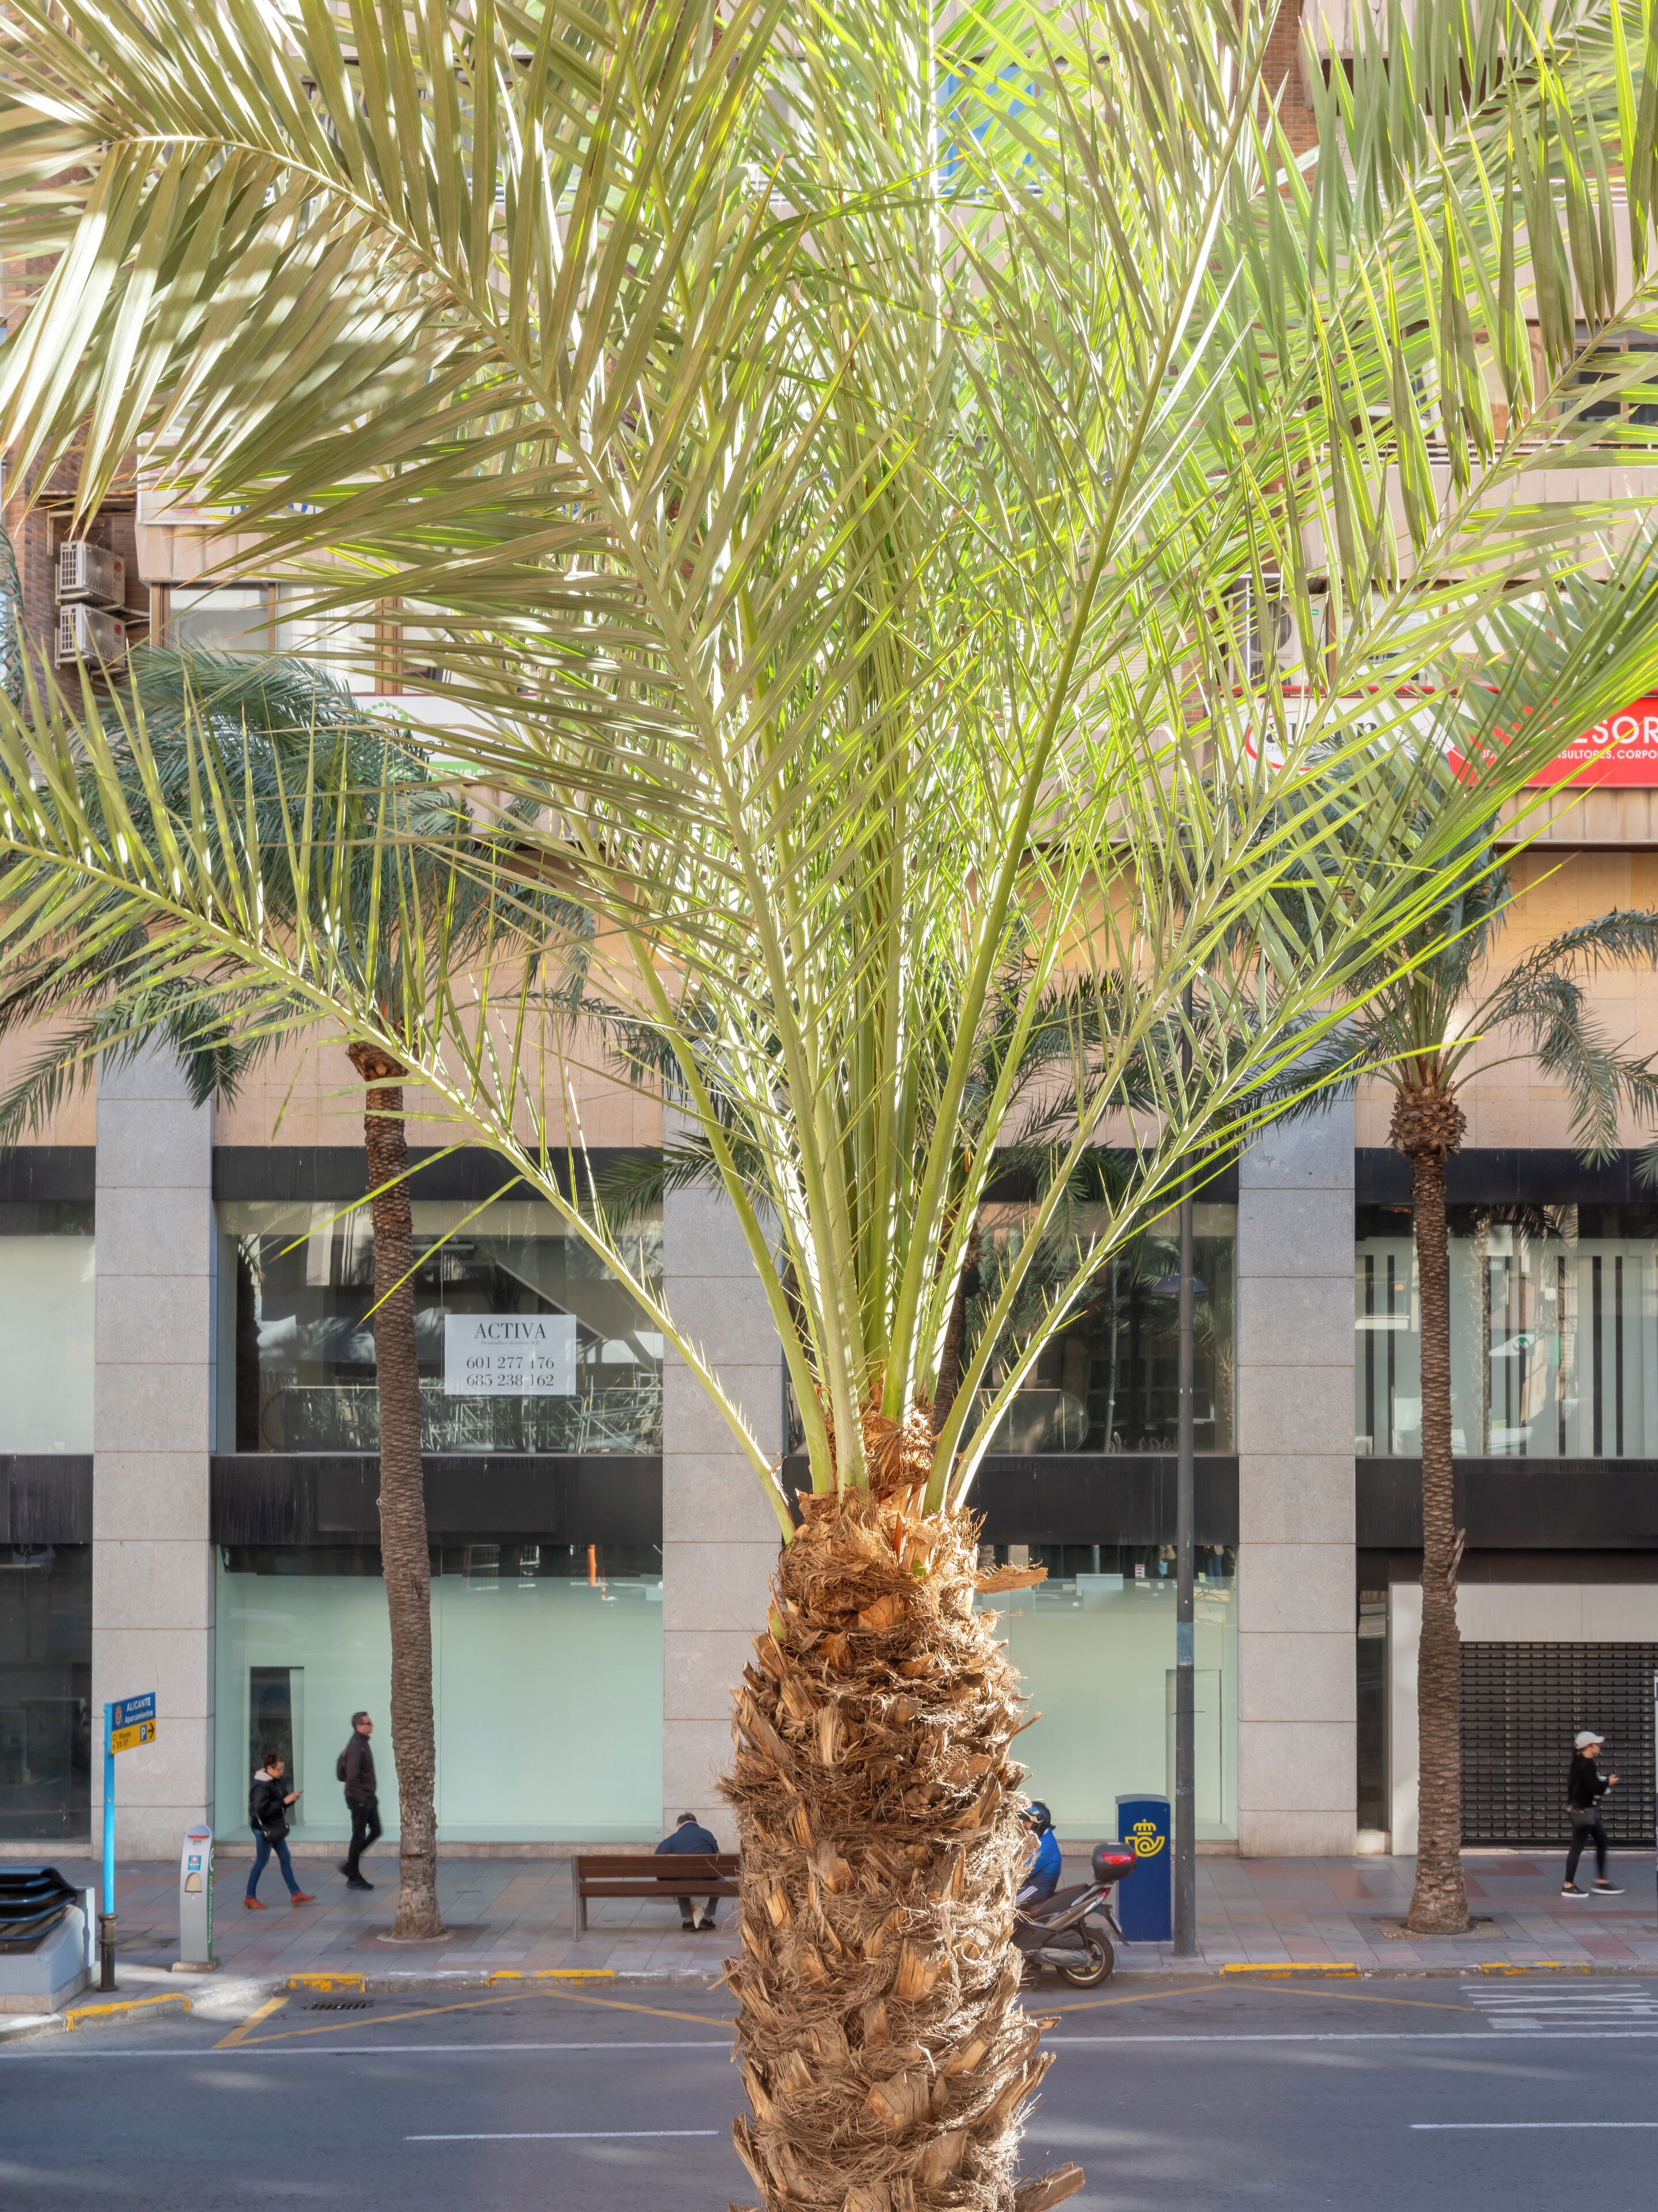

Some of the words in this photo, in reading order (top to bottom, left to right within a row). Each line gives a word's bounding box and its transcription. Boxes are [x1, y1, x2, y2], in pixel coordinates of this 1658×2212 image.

[474, 1322, 547, 1339] ACTIVA
[467, 1356, 492, 1369] 601
[497, 1356, 523, 1369] 277
[529, 1356, 554, 1369] 176
[467, 1373, 493, 1387] 685
[497, 1373, 523, 1387] 238
[530, 1373, 554, 1387] 162
[126, 1697, 151, 1712] ALICANTE
[124, 1709, 153, 1724] Aparcamientos
[119, 1731, 131, 1740] Navas
